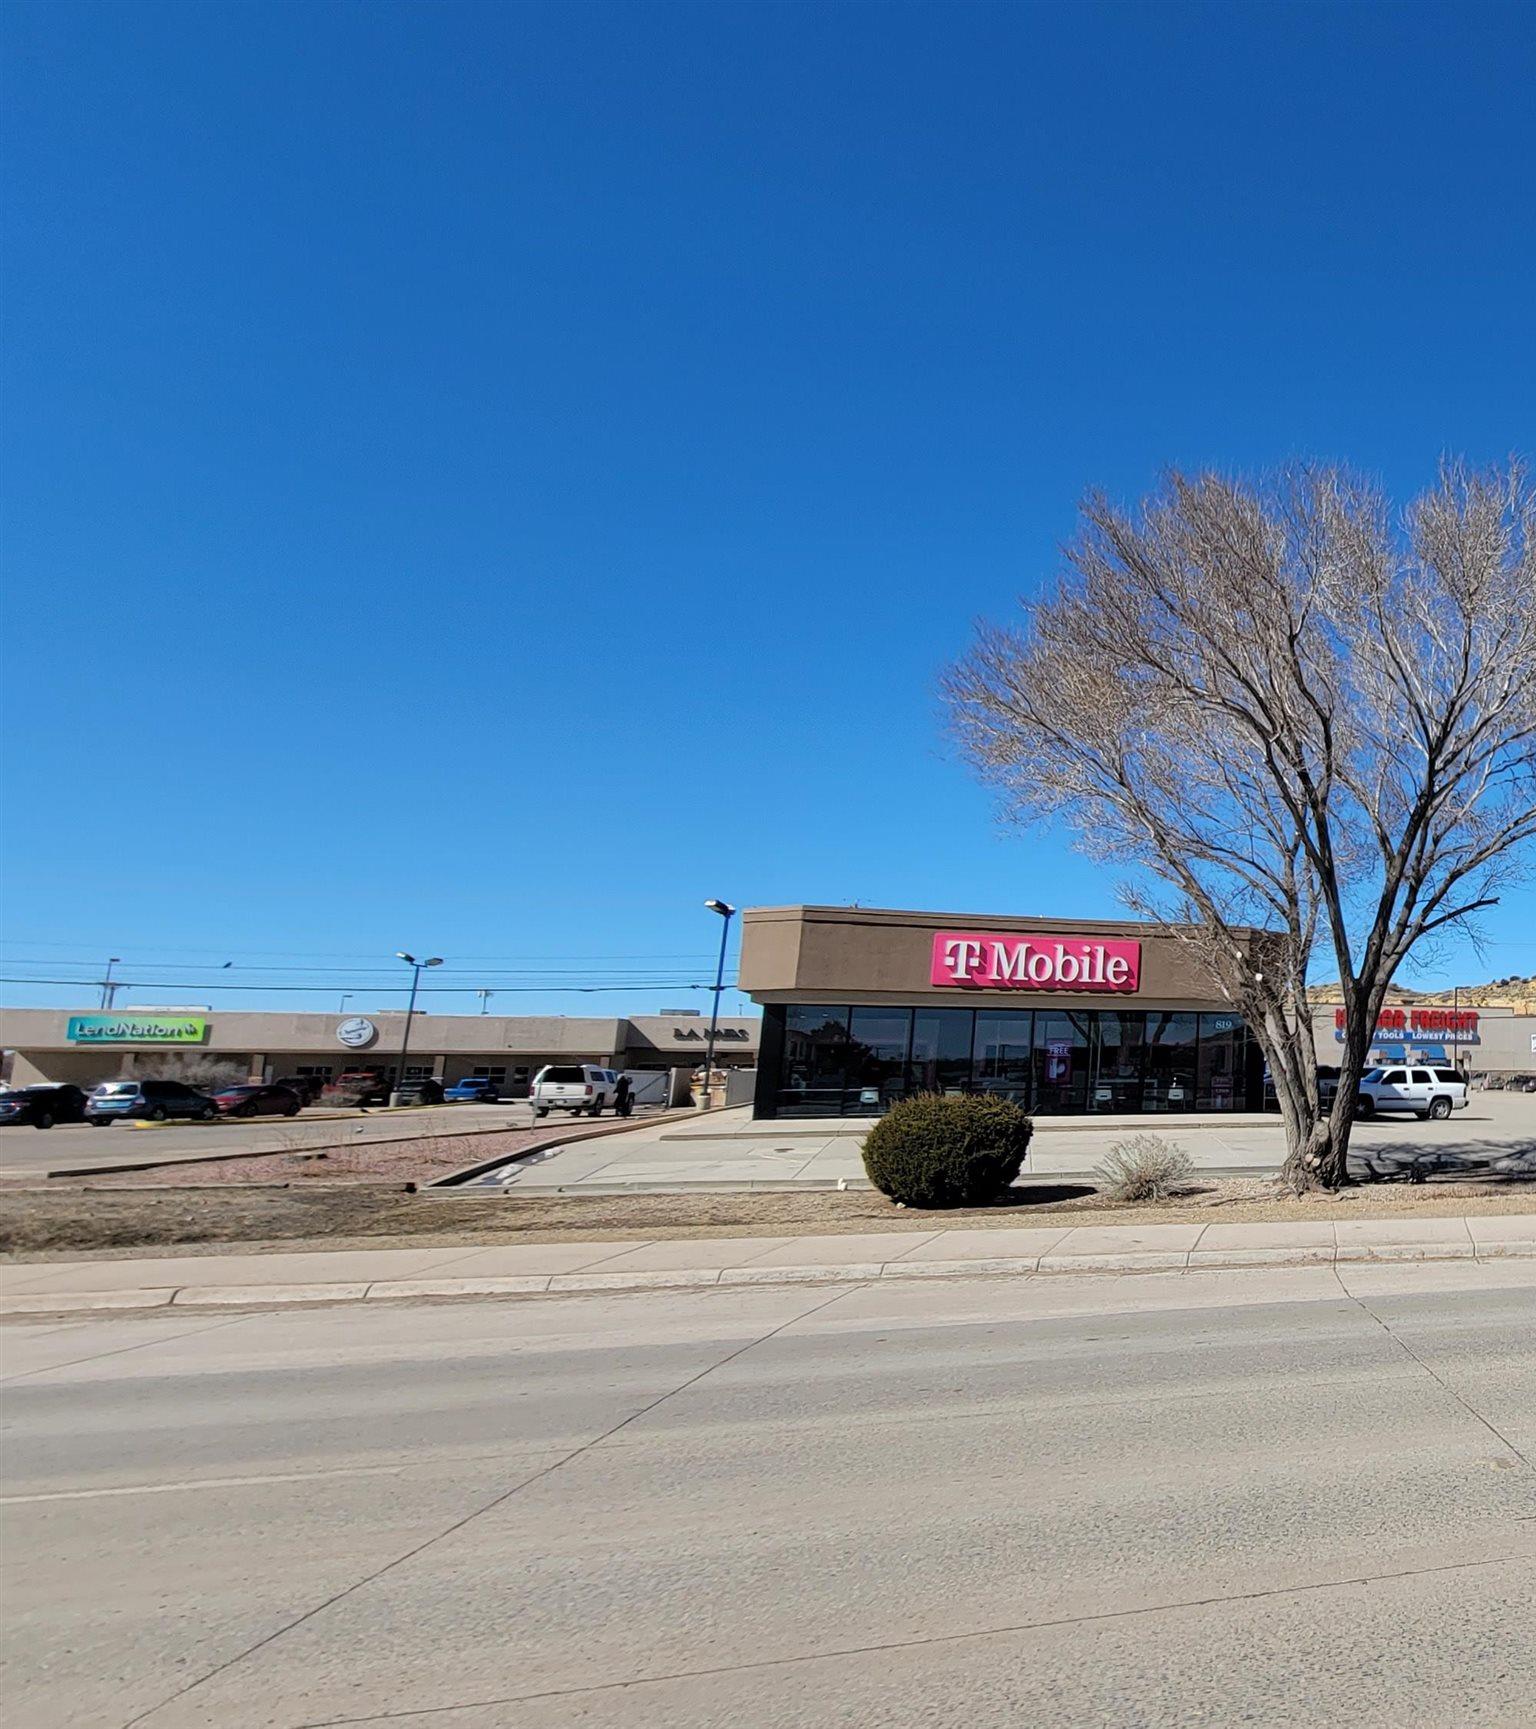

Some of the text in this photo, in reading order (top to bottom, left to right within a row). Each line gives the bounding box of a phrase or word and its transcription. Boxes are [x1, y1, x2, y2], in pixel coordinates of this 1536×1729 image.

[988, 942, 1129, 984] Mobile
[1215, 1020, 1232, 1029] 819
[1336, 1009, 1479, 1029] HOR FREIGHT
[76, 1022, 179, 1037] LendNation
[1412, 1032, 1443, 1040] LOWEST
